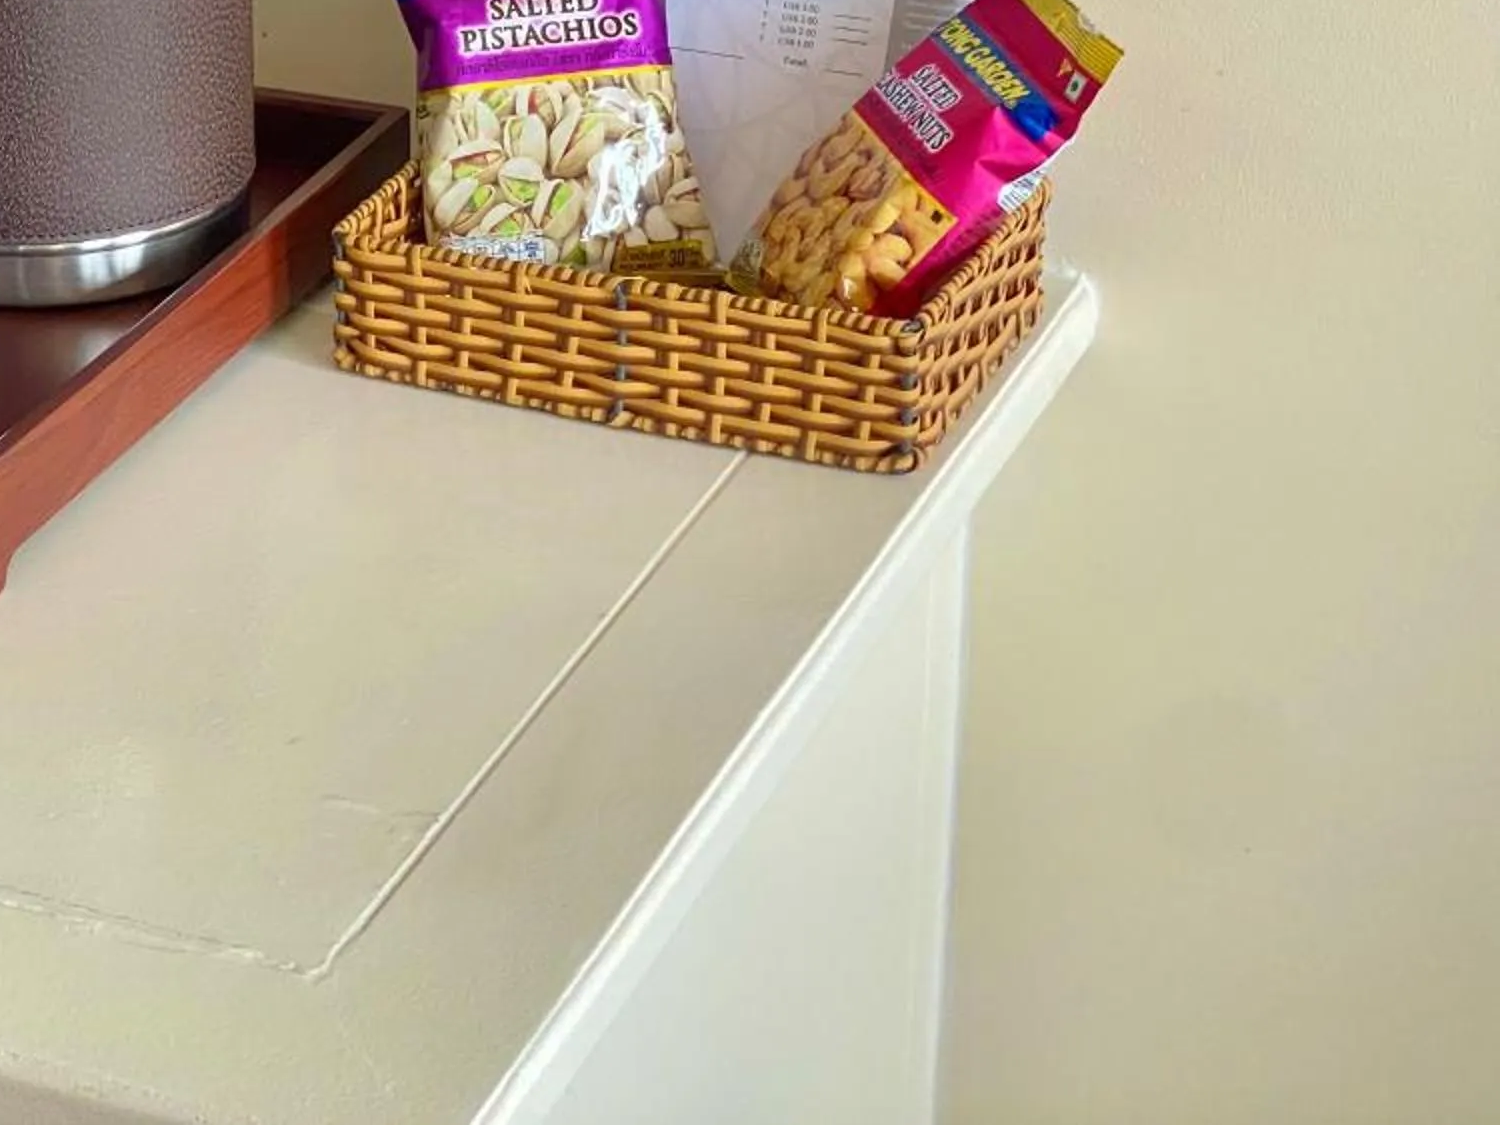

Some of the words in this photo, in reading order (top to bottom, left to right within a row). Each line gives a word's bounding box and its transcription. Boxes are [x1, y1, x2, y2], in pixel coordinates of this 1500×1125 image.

[460, 12, 638, 53] PISTACHIOS
[912, 64, 960, 111] SALTED
[963, 46, 1031, 104] GARDEN
[913, 108, 951, 151] NUTS
